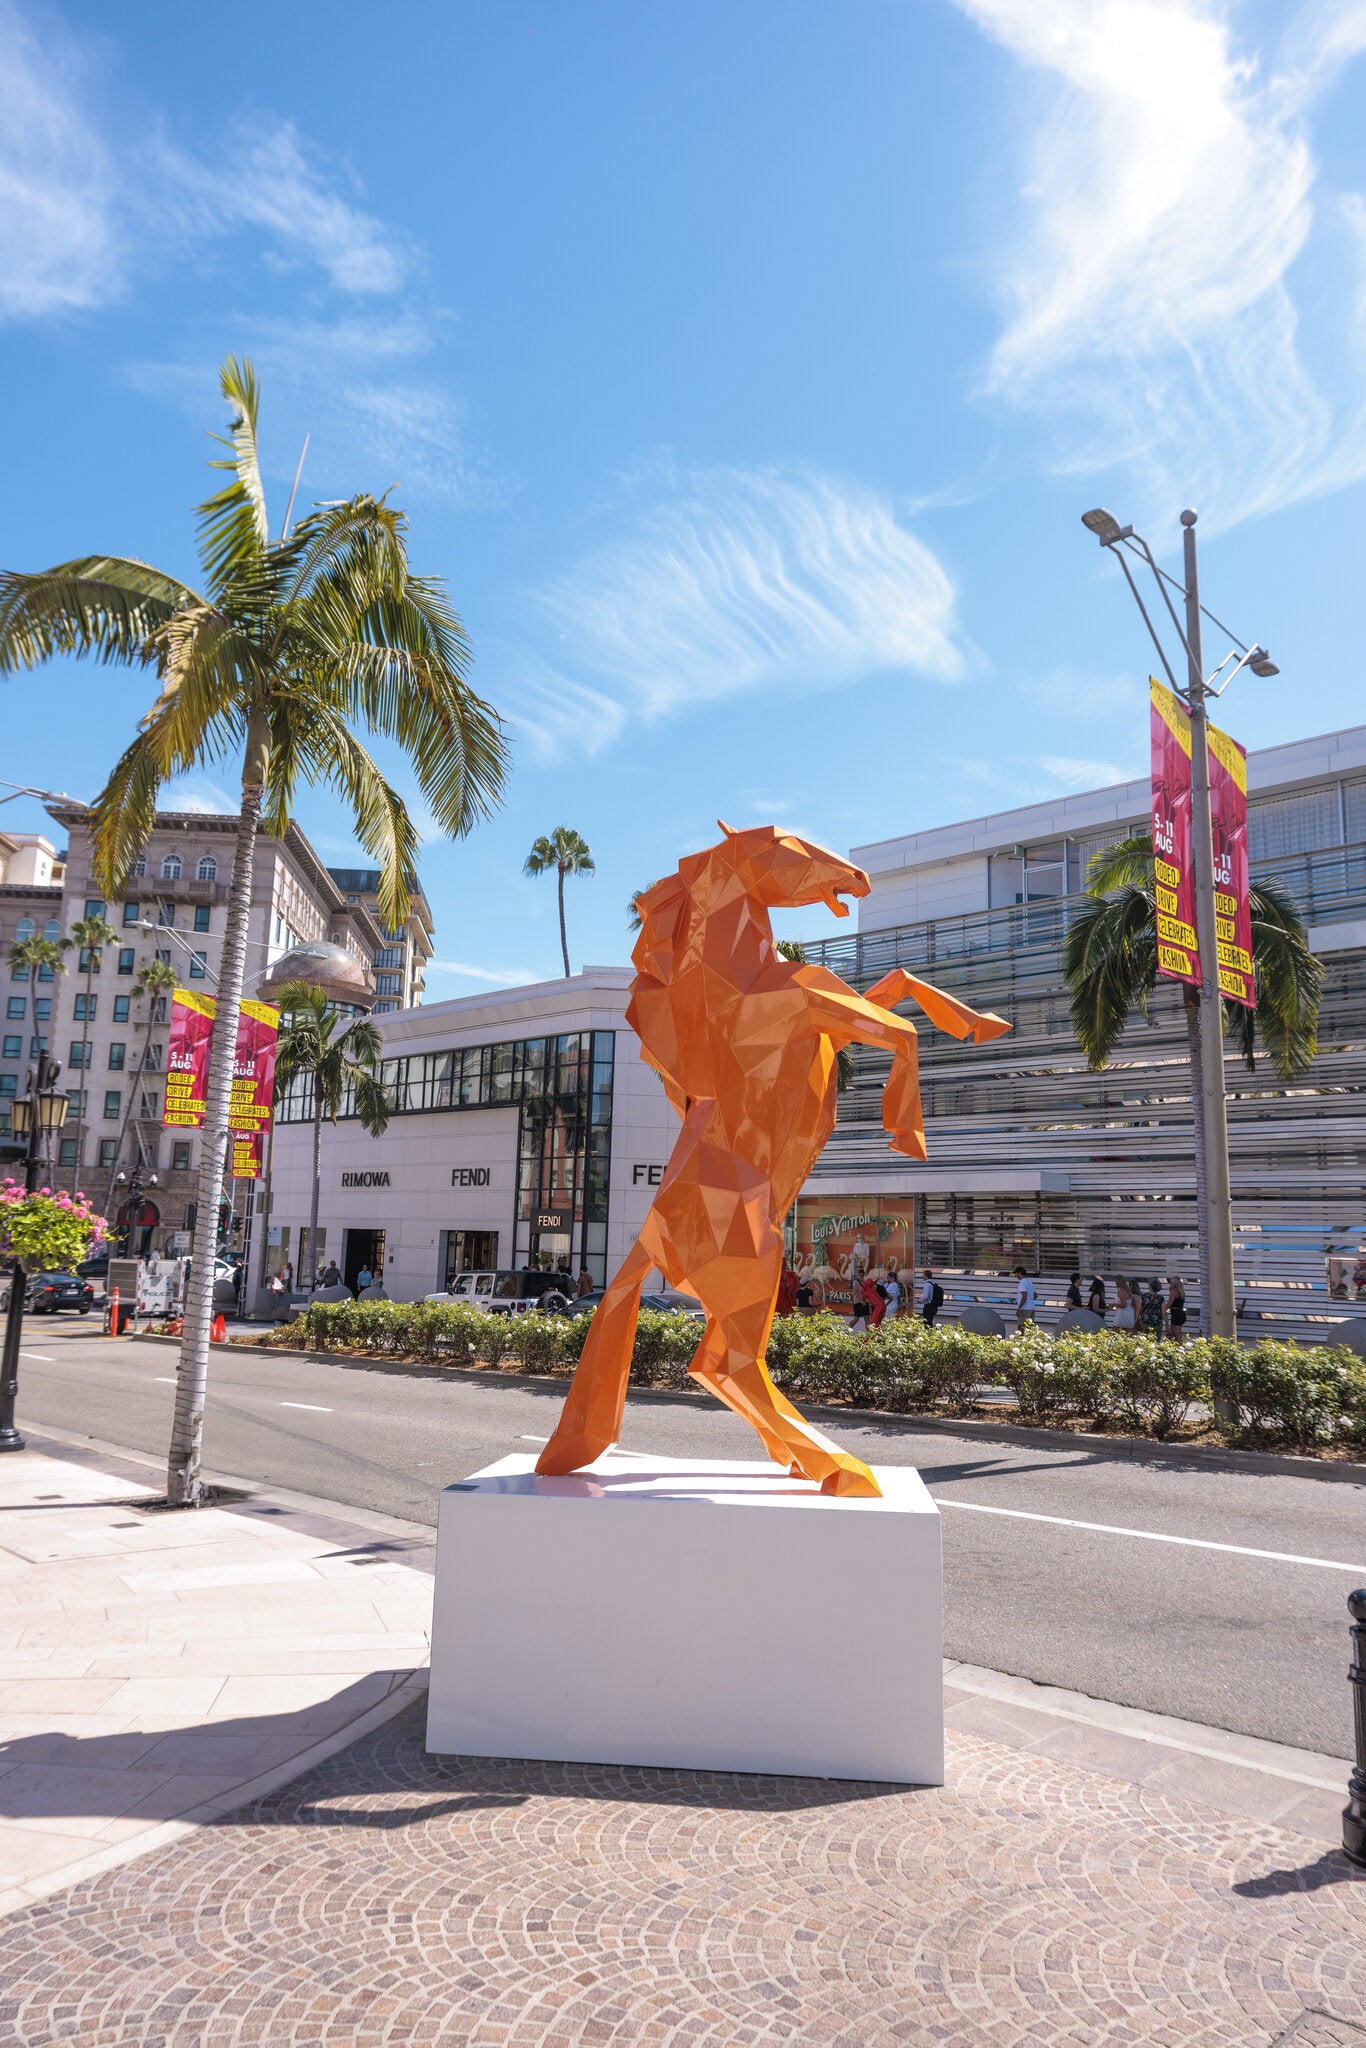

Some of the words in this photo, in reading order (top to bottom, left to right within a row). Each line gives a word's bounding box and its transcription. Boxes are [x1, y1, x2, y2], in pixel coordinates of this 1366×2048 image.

[1154, 812, 1160, 828] 5
[1166, 820, 1174, 838] 11
[1155, 831, 1173, 854] AUG
[1221, 854, 1231, 869] 11
[1156, 859, 1176, 886] RODEO
[1214, 867, 1230, 885] UG
[1157, 886, 1176, 912] DRIVE
[1215, 894, 1233, 914] ODEO
[1158, 916, 1194, 947] CELEBRATES
[1216, 918, 1232, 938] RIVE
[1160, 946, 1188, 972] FASHION
[1218, 944, 1248, 970] ELEBRATES
[1219, 971, 1242, 994] ASHION
[170, 1060, 191, 1069] AUG
[170, 1074, 191, 1084] RODEO
[232, 1080, 254, 1090] RODEO
[168, 1086, 189, 1097] DRIVE
[232, 1093, 250, 1103] DRIVE
[168, 1100, 204, 1111] CELEBRATES
[230, 1105, 266, 1116] CELEBRATES
[166, 1114, 194, 1124] FASHION
[230, 1119, 256, 1129] FASHION
[341, 1172, 390, 1187] RIMOWA
[452, 1168, 490, 1186] FENDI
[633, 1164, 667, 1186] FE
[538, 1215, 561, 1226] FENDI
[829, 1291, 851, 1300] PARIS
